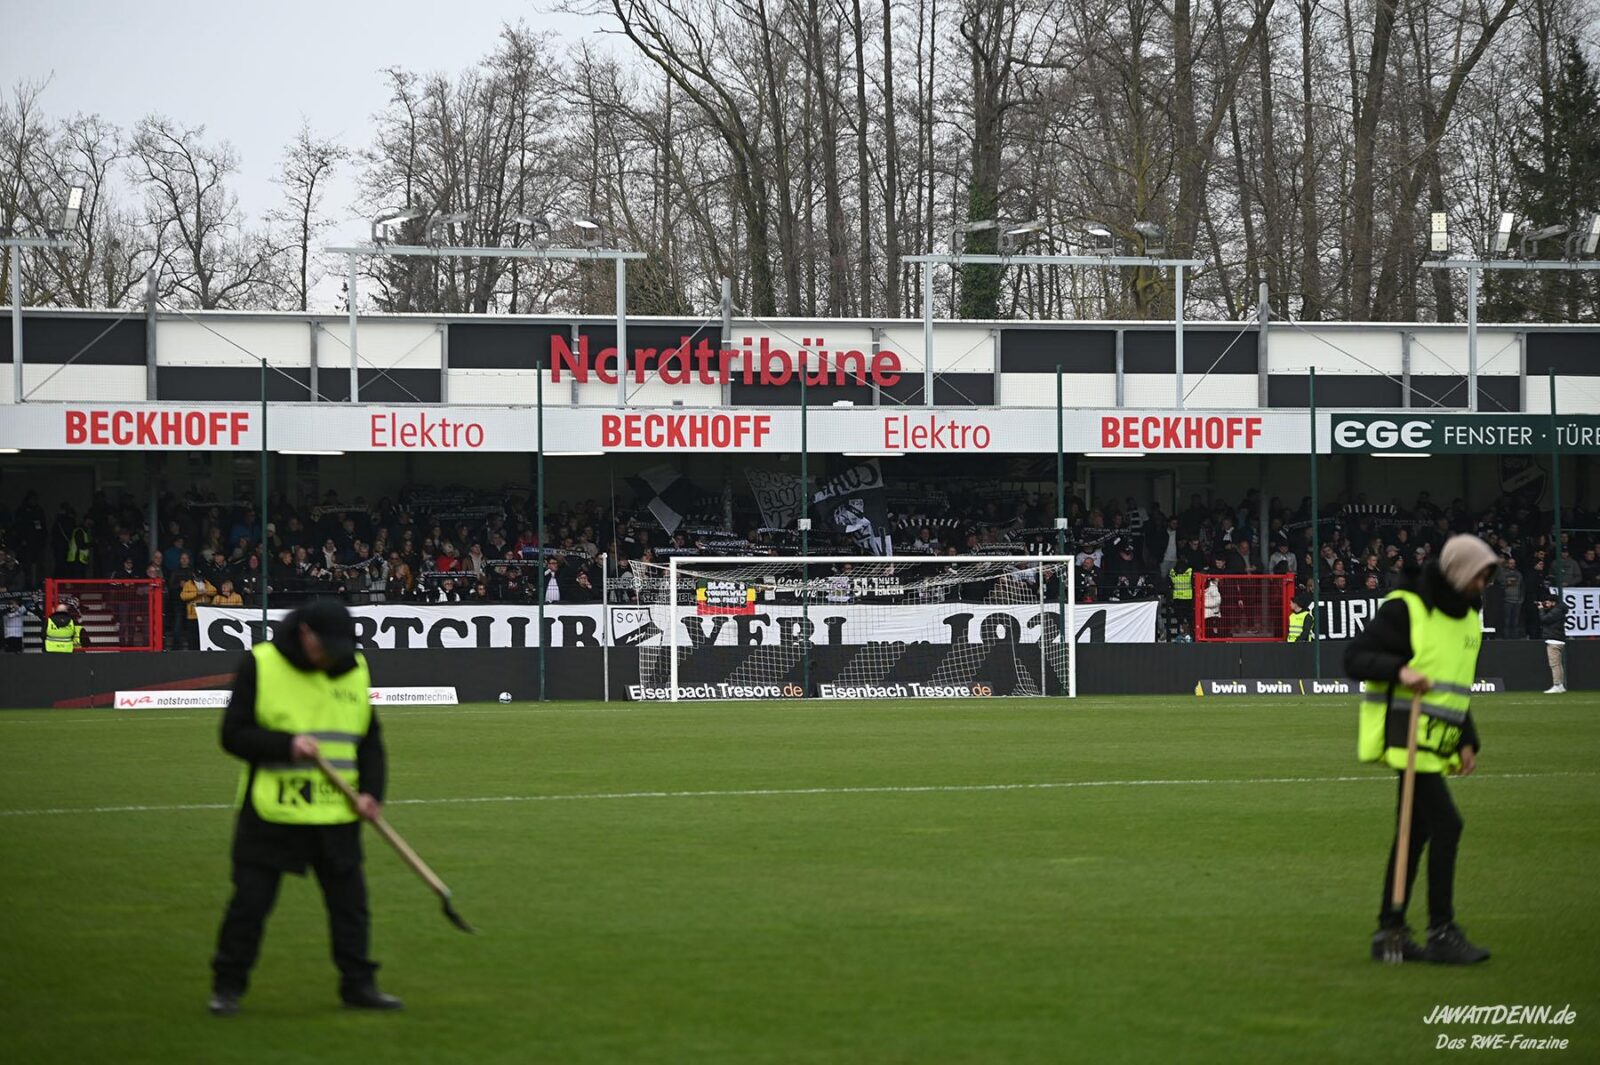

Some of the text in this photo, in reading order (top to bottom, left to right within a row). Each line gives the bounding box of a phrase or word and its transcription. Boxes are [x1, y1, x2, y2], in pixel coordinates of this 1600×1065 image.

[551, 334, 902, 387] Nordtribüne
[66, 410, 249, 446] BECKHOFF
[371, 412, 485, 448] Elektro
[602, 415, 771, 448] BECKHOFF
[884, 415, 991, 450] Elektro
[1101, 416, 1262, 449] BECKHOFF
[1334, 420, 1432, 449] EGE
[1444, 426, 1533, 446] FENSTER
[616, 612, 643, 624] SCV
[386, 690, 454, 702] notstromtechnik
[629, 682, 803, 701] Eisenbach Tresore.de
[820, 682, 992, 699] Eisenbach Tresore.de
[1211, 680, 1292, 694] bwin bwin
[1313, 680, 1349, 694] bwin
[1470, 679, 1496, 693] win
